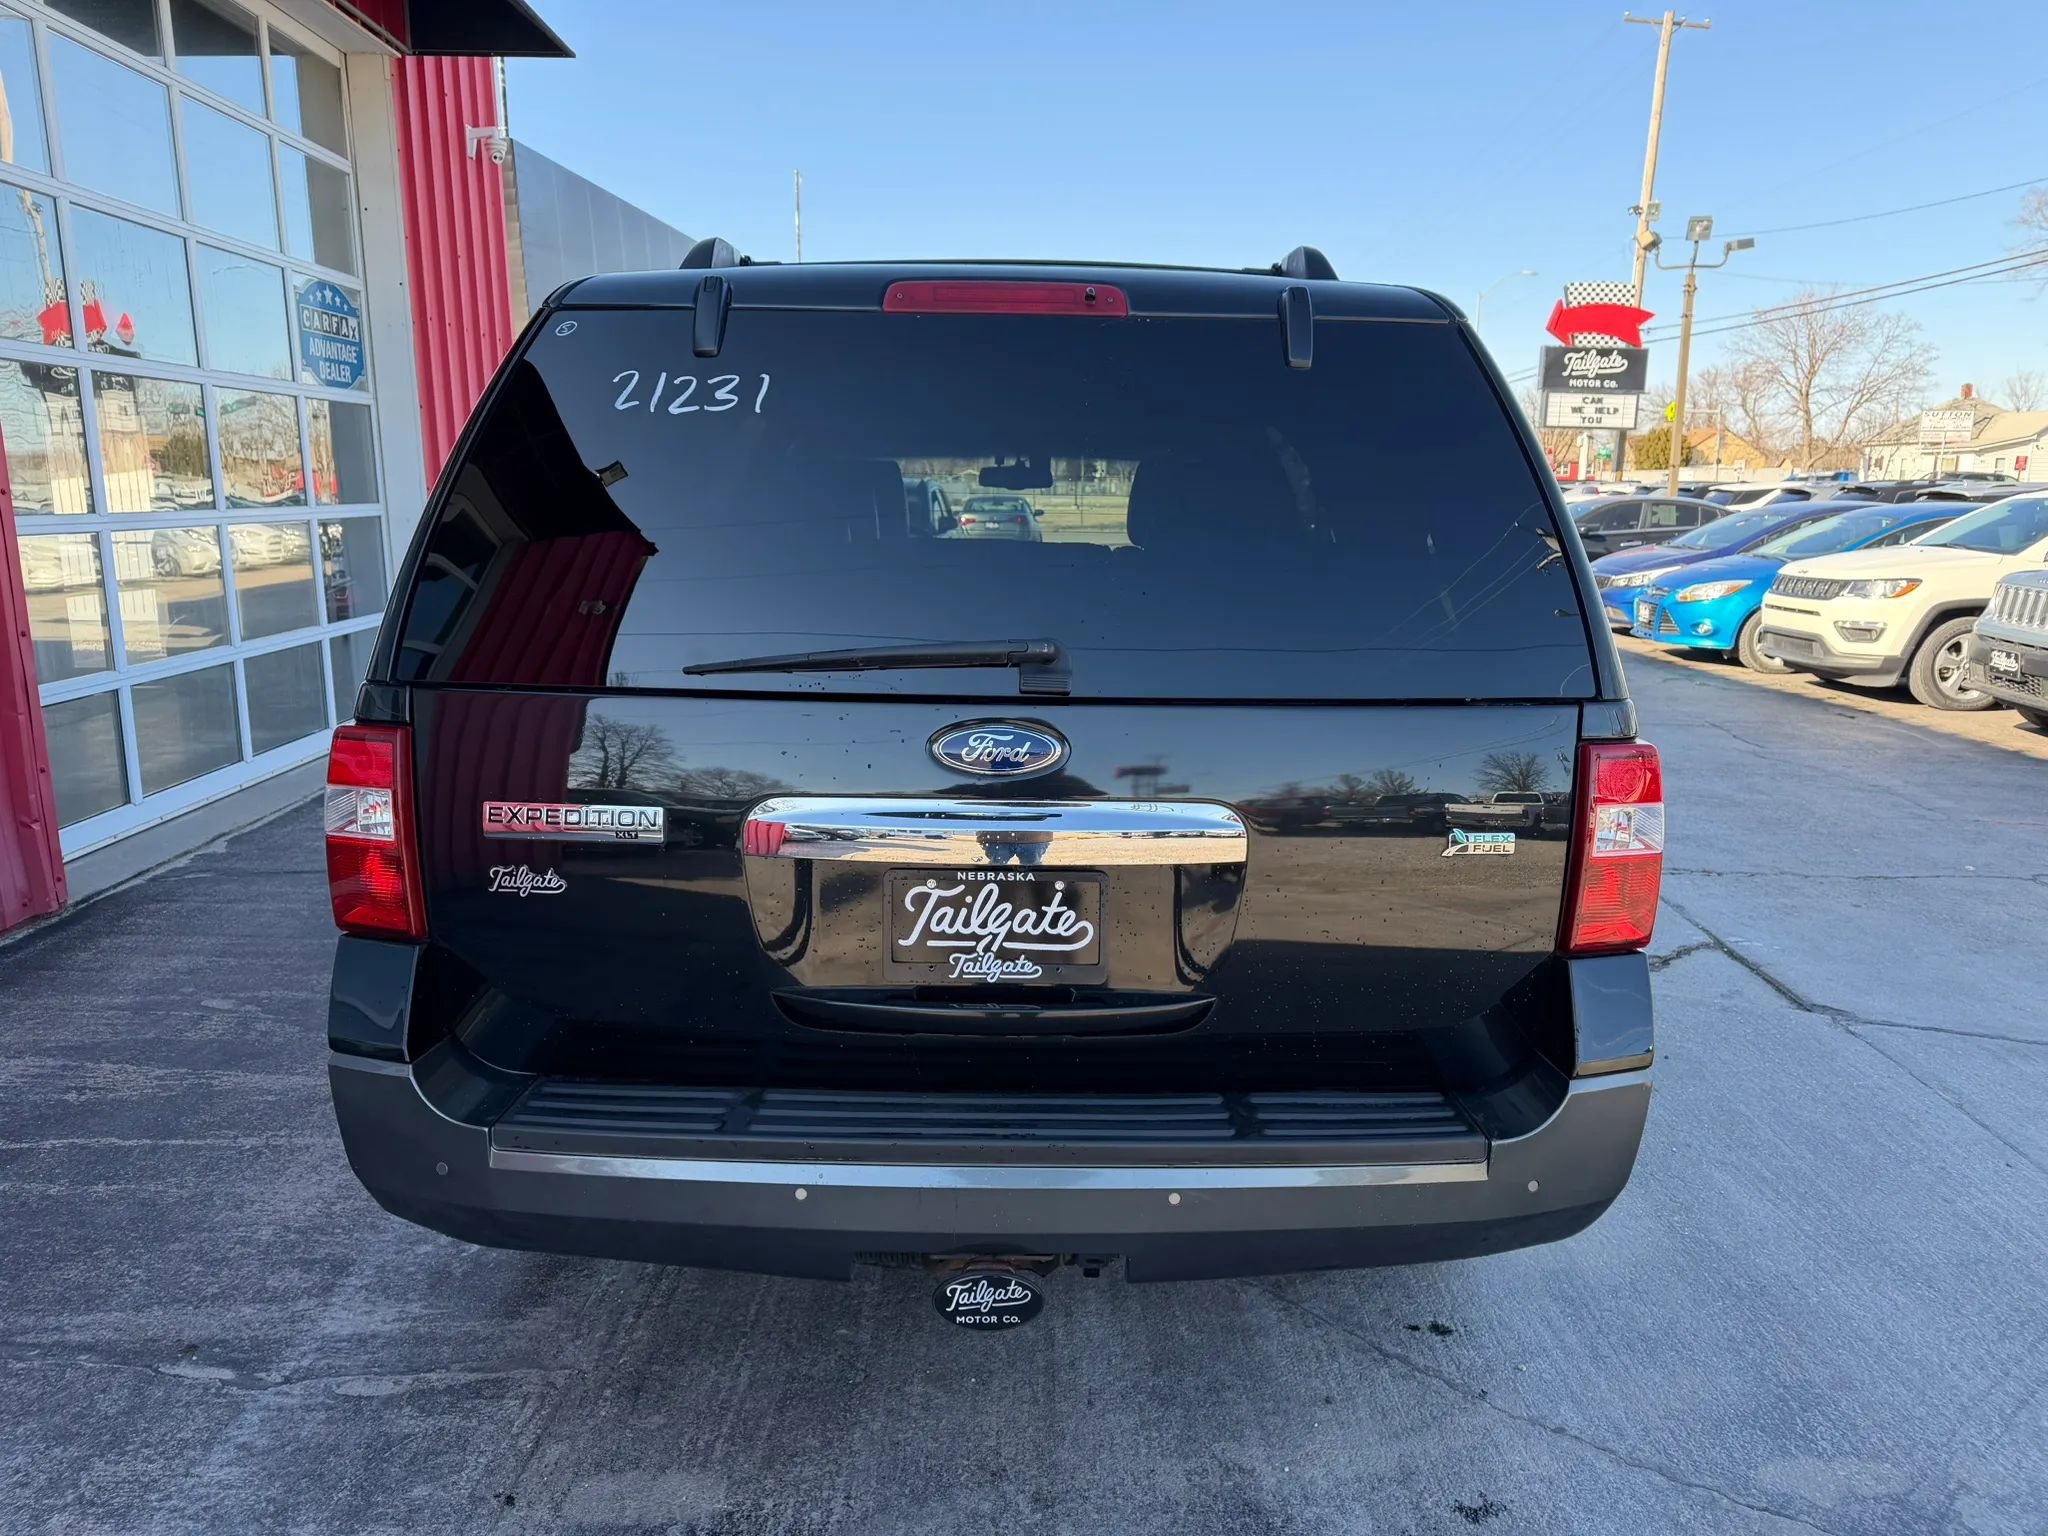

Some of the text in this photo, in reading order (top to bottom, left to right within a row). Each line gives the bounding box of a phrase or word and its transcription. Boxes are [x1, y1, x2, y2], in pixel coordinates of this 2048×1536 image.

[303, 309, 358, 340] CARFAX
[309, 337, 358, 364] ADVANTAGE
[319, 361, 352, 383] DEALER
[1562, 349, 1628, 378] Tailgate
[613, 370, 770, 415] 21231
[1569, 379, 1619, 388] MOTOR CO.
[1571, 406, 1620, 415] WE HELP
[1582, 396, 1604, 405] CAN
[1581, 416, 1603, 424] YOU
[961, 733, 1031, 762] Ford
[487, 806, 659, 828] EXPEDITION
[616, 831, 639, 839] XLT
[1473, 834, 1512, 843] FLEX
[1473, 844, 1510, 853] FUEL
[488, 864, 568, 897] Tailgate
[957, 871, 1036, 882] NEBRASKA
[898, 882, 1094, 955] Tailgate
[948, 952, 1043, 983] Tailgate
[945, 1280, 1032, 1312] Tailgate
[956, 1315, 1021, 1324] MOTOR CO.
